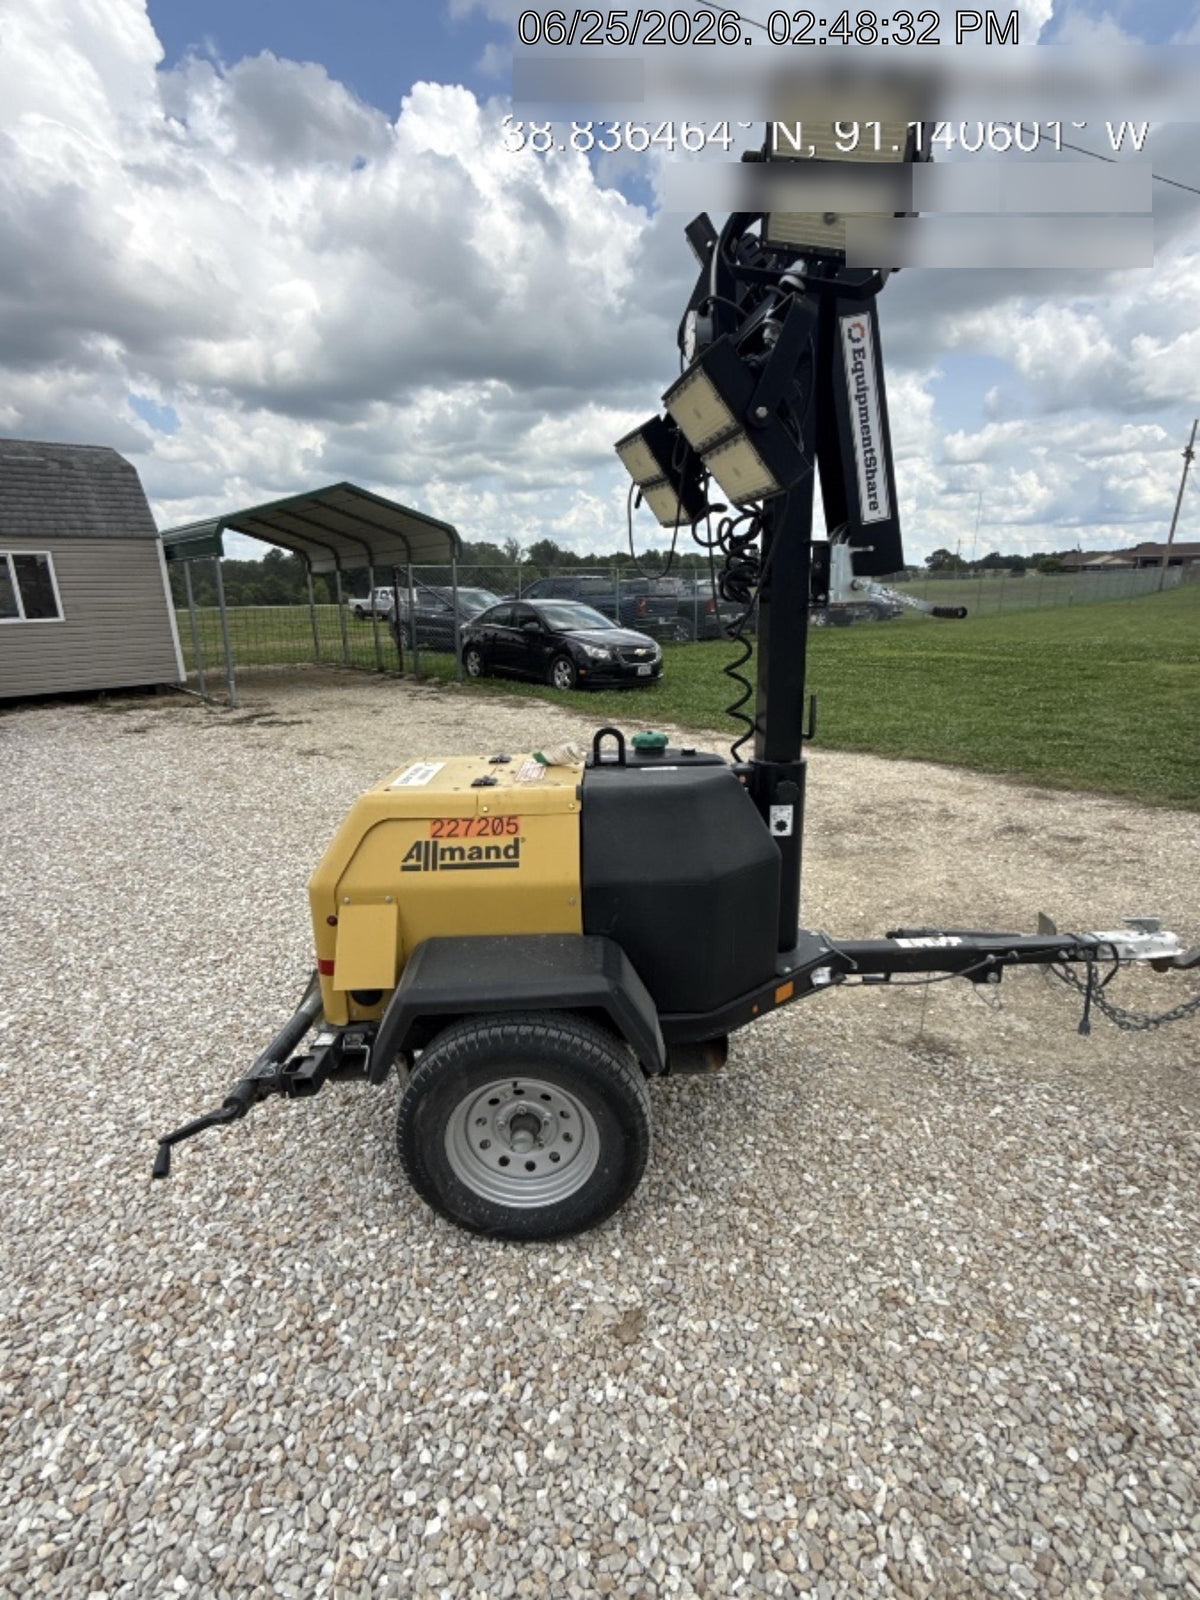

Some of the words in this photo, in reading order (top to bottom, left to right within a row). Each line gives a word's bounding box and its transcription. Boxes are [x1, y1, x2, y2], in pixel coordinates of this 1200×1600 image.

[850, 346, 880, 512] EquipmentShare
[430, 816, 519, 839] 227205
[400, 837, 520, 872] Allmand
